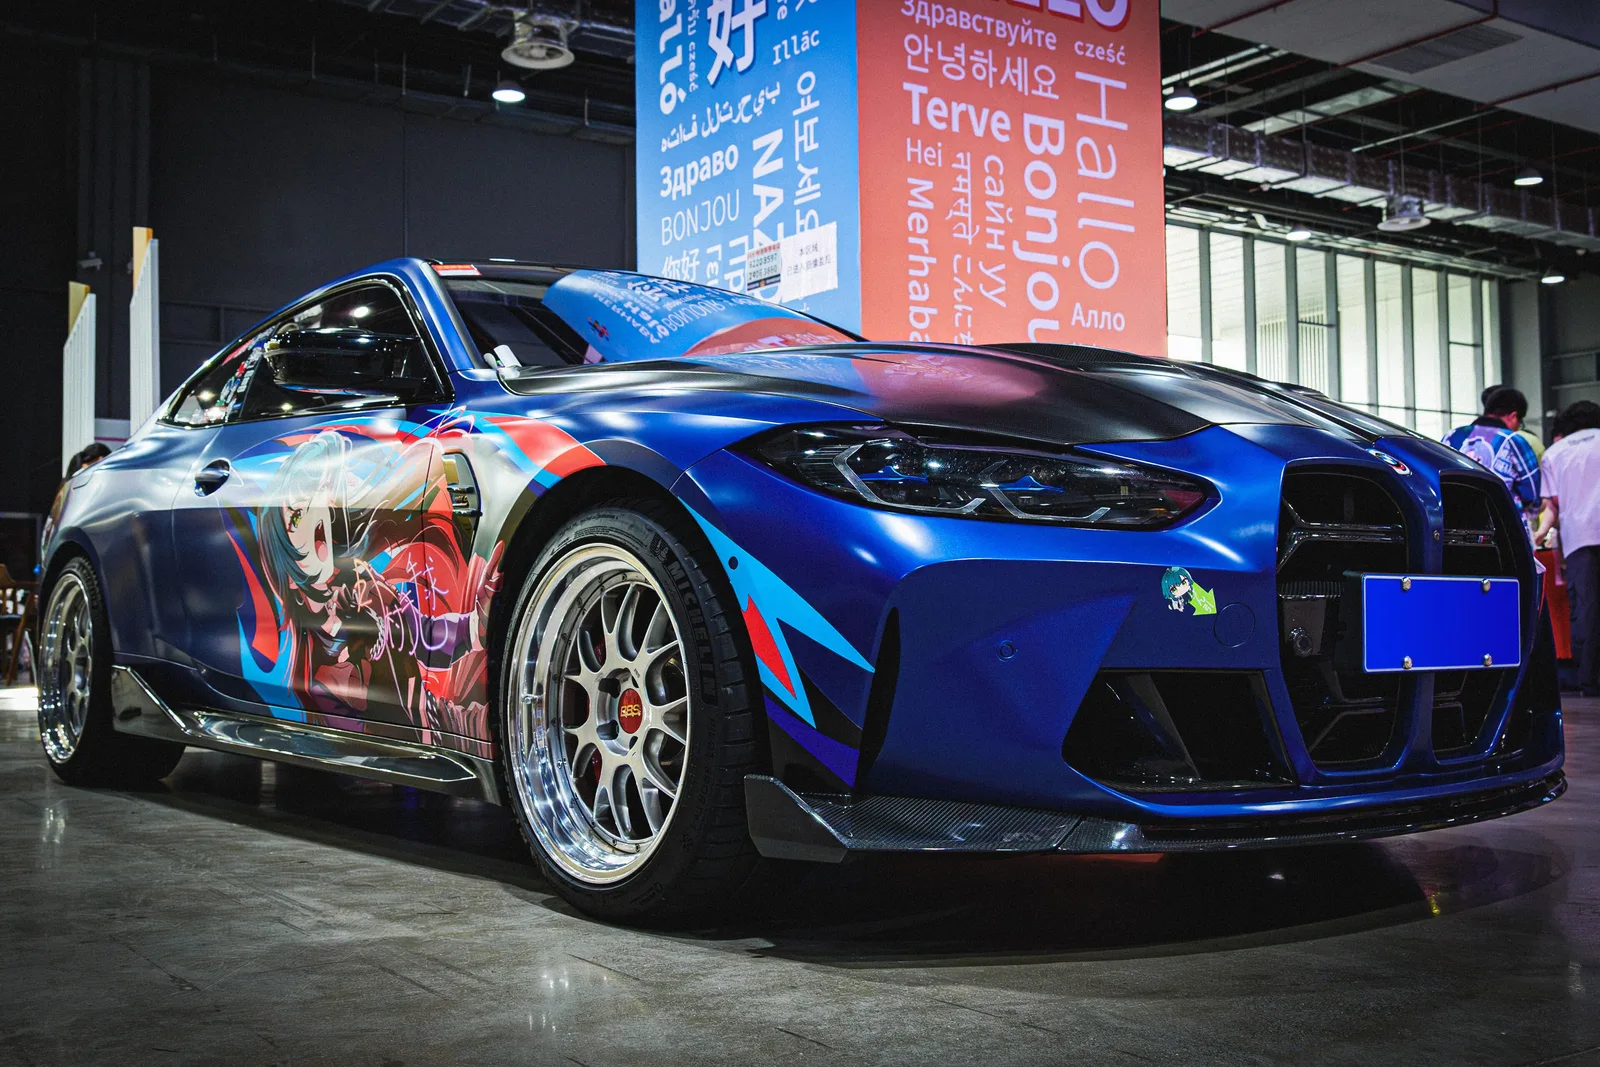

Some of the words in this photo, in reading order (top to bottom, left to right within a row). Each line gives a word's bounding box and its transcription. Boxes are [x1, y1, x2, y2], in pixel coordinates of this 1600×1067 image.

[901, 0, 1057, 50] Здравствуйте
[903, 33, 1060, 100] 안녕하세요
[1074, 40, 1126, 66] cześć
[902, 81, 1011, 142] Terve
[660, 144, 739, 201] Здраво
[906, 137, 942, 168] Hei
[661, 189, 740, 246] BONJOU
[945, 152, 980, 245] नमस्ते
[661, 248, 700, 282] 你好
[1071, 302, 1126, 332] Алло
[667, 560, 716, 697] MICHELIN
[620, 704, 641, 718] BBS
